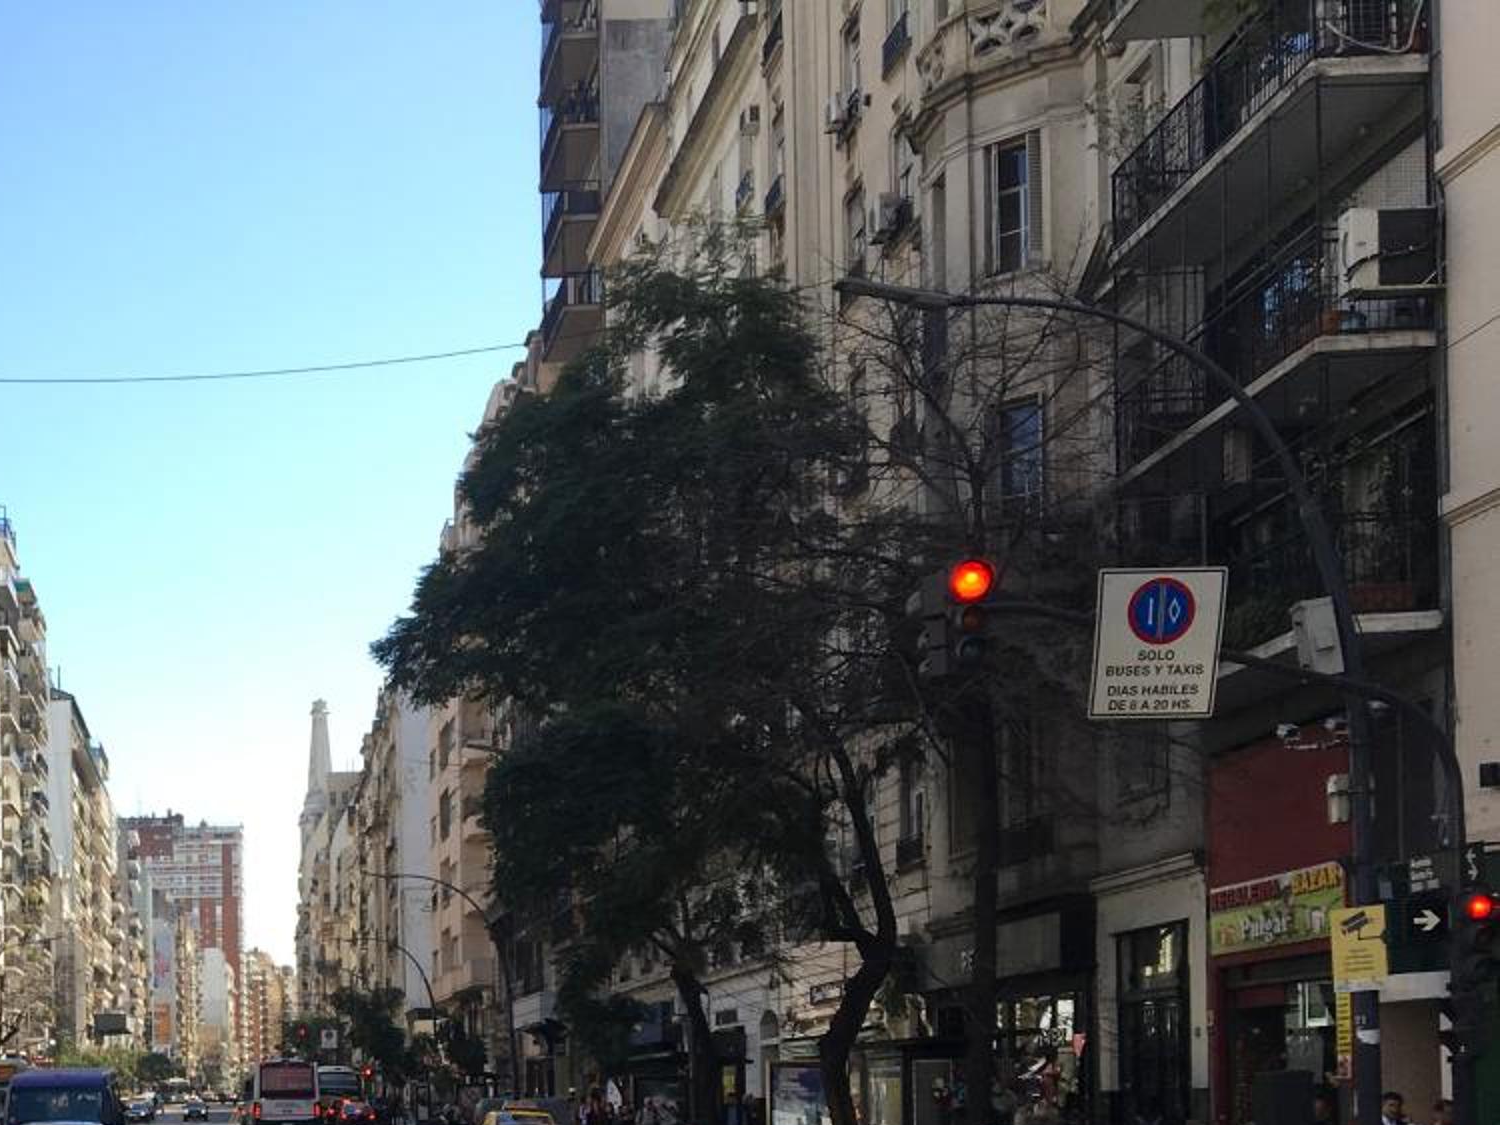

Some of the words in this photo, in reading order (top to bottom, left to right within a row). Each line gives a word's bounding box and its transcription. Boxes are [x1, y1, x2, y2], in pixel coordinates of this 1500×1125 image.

[1137, 649, 1175, 661] SOLO
[1105, 665, 1150, 677] BUSES
[1154, 664, 1164, 676] Y
[1167, 663, 1205, 675] TAXIS
[1107, 685, 1138, 697] DIAS
[1141, 684, 1199, 696] HABILES
[1108, 700, 1127, 711] DE
[1140, 700, 1150, 711] A
